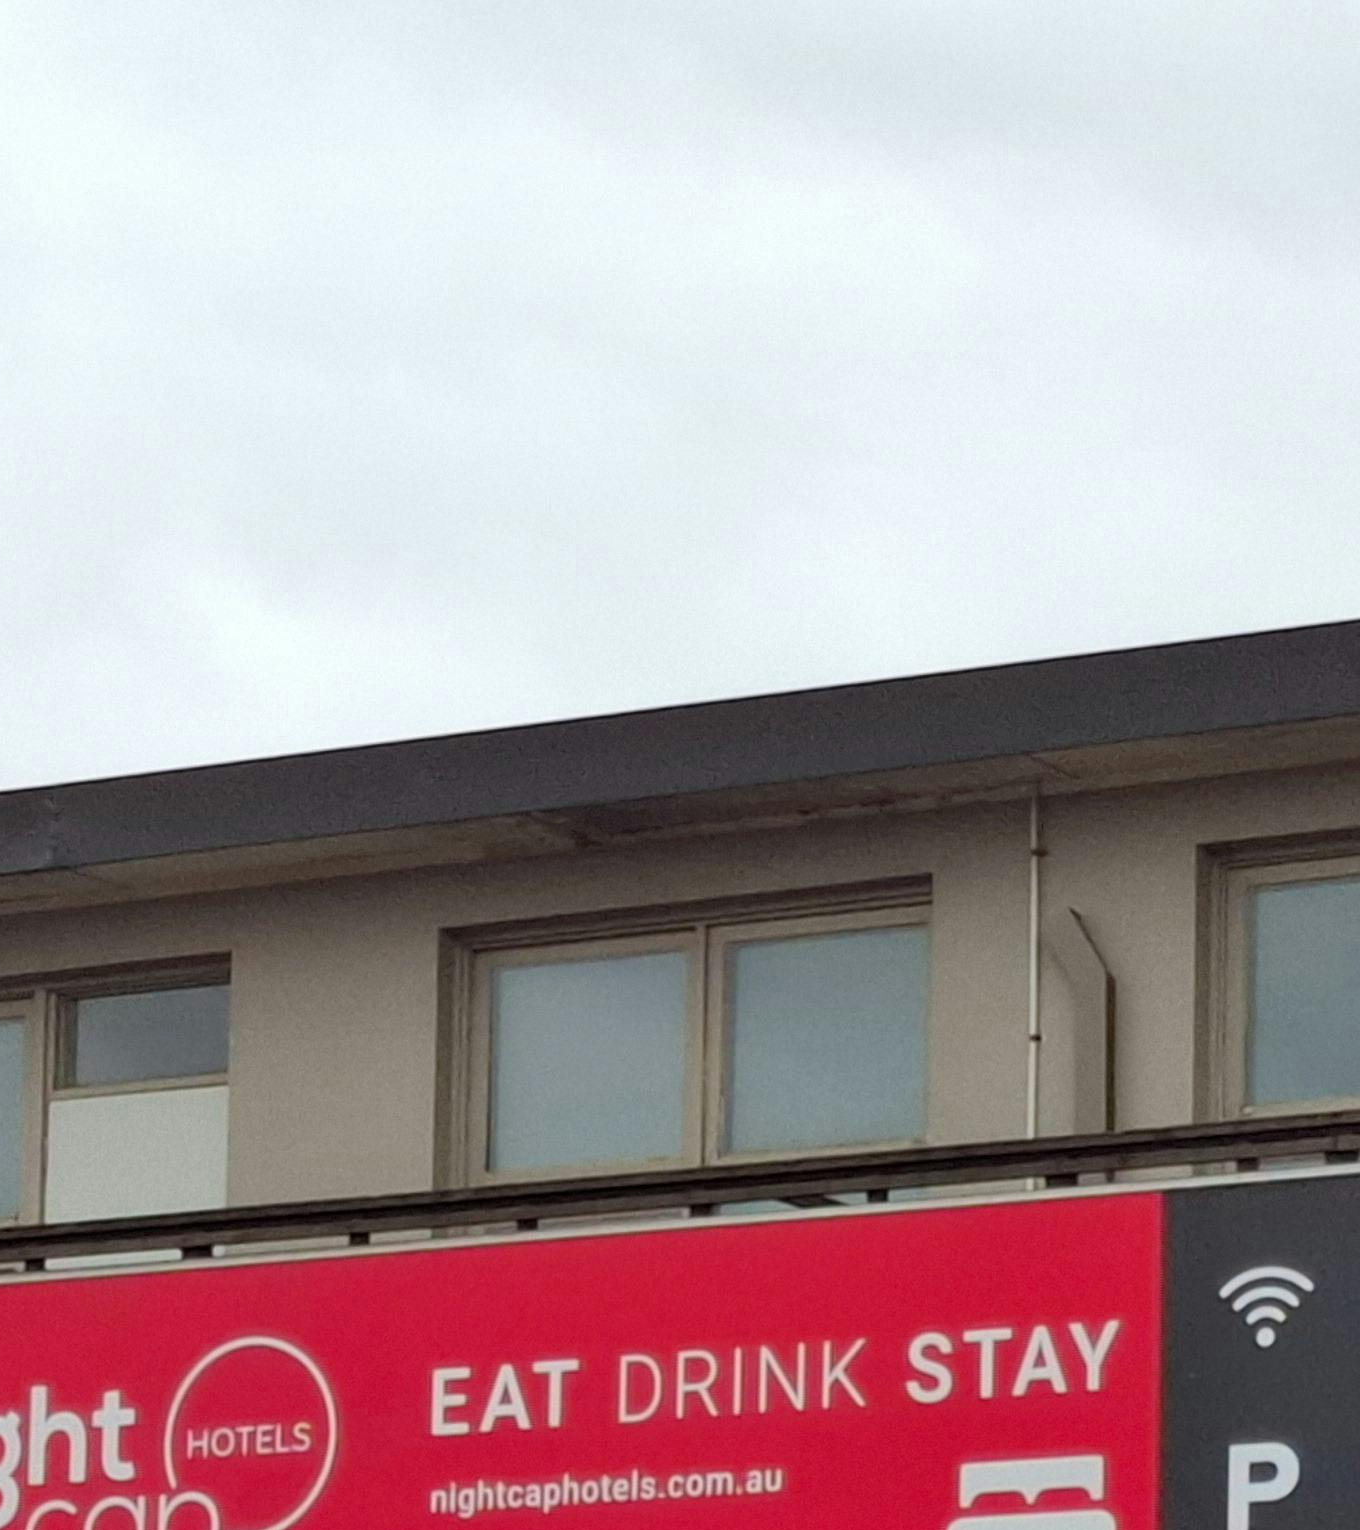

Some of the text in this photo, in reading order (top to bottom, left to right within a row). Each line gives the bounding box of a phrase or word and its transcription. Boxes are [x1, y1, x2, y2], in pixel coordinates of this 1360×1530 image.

[430, 1319, 1120, 1436] EAT DRINK STAY
[186, 1421, 312, 1459] HOTELS
[429, 1466, 784, 1519] nightcaphotels.com.au
